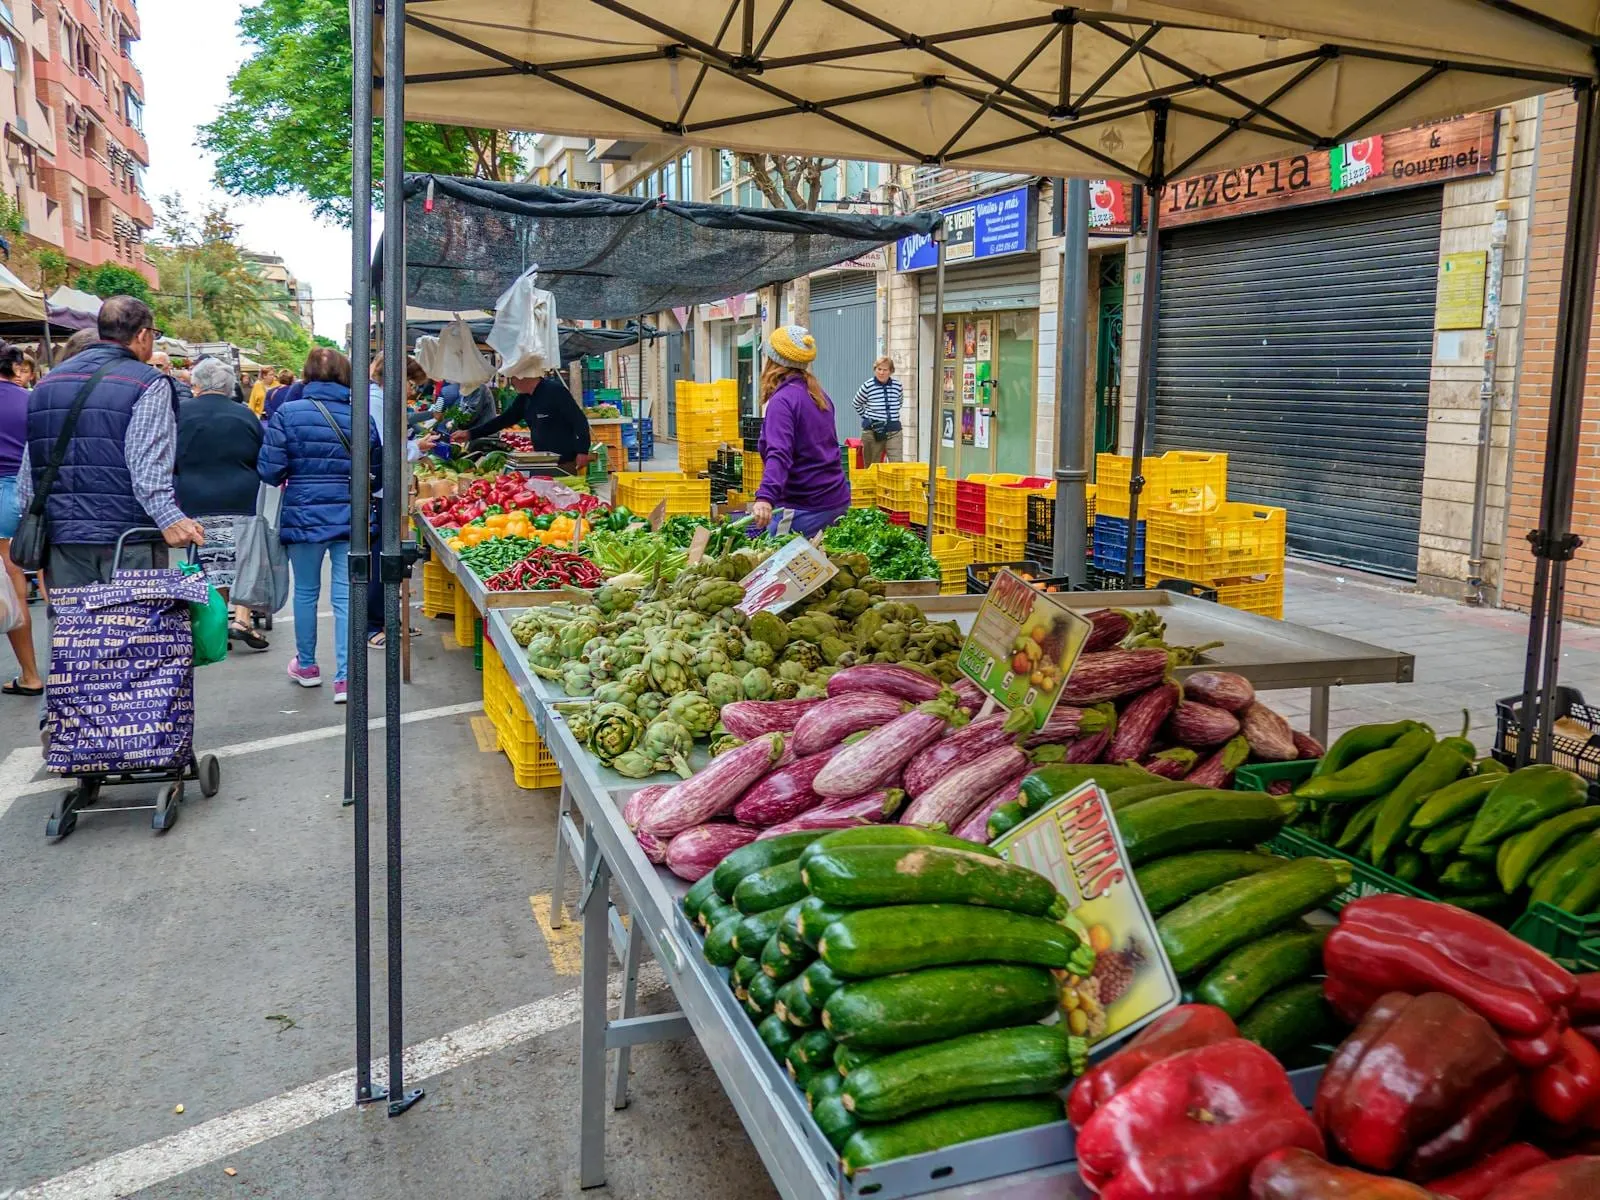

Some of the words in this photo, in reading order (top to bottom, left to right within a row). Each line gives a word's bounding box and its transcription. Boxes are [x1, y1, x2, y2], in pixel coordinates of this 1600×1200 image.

[1430, 129, 1441, 149] &
[1392, 147, 1479, 179] Gourmet
[1342, 165, 1371, 184] pizza
[1159, 155, 1310, 212] izzeria
[954, 209, 975, 230] VENDE
[88, 588, 127, 602] miami
[52, 649, 91, 660] ERLIN
[63, 658, 130, 671] TOKIO
[83, 681, 123, 691] moskva
[108, 691, 133, 702] SAN
[111, 699, 168, 711] BARCELONA
[111, 722, 173, 737] MILANO
[107, 735, 156, 750] MIAMI
[1056, 788, 1125, 901] FRUTAS
